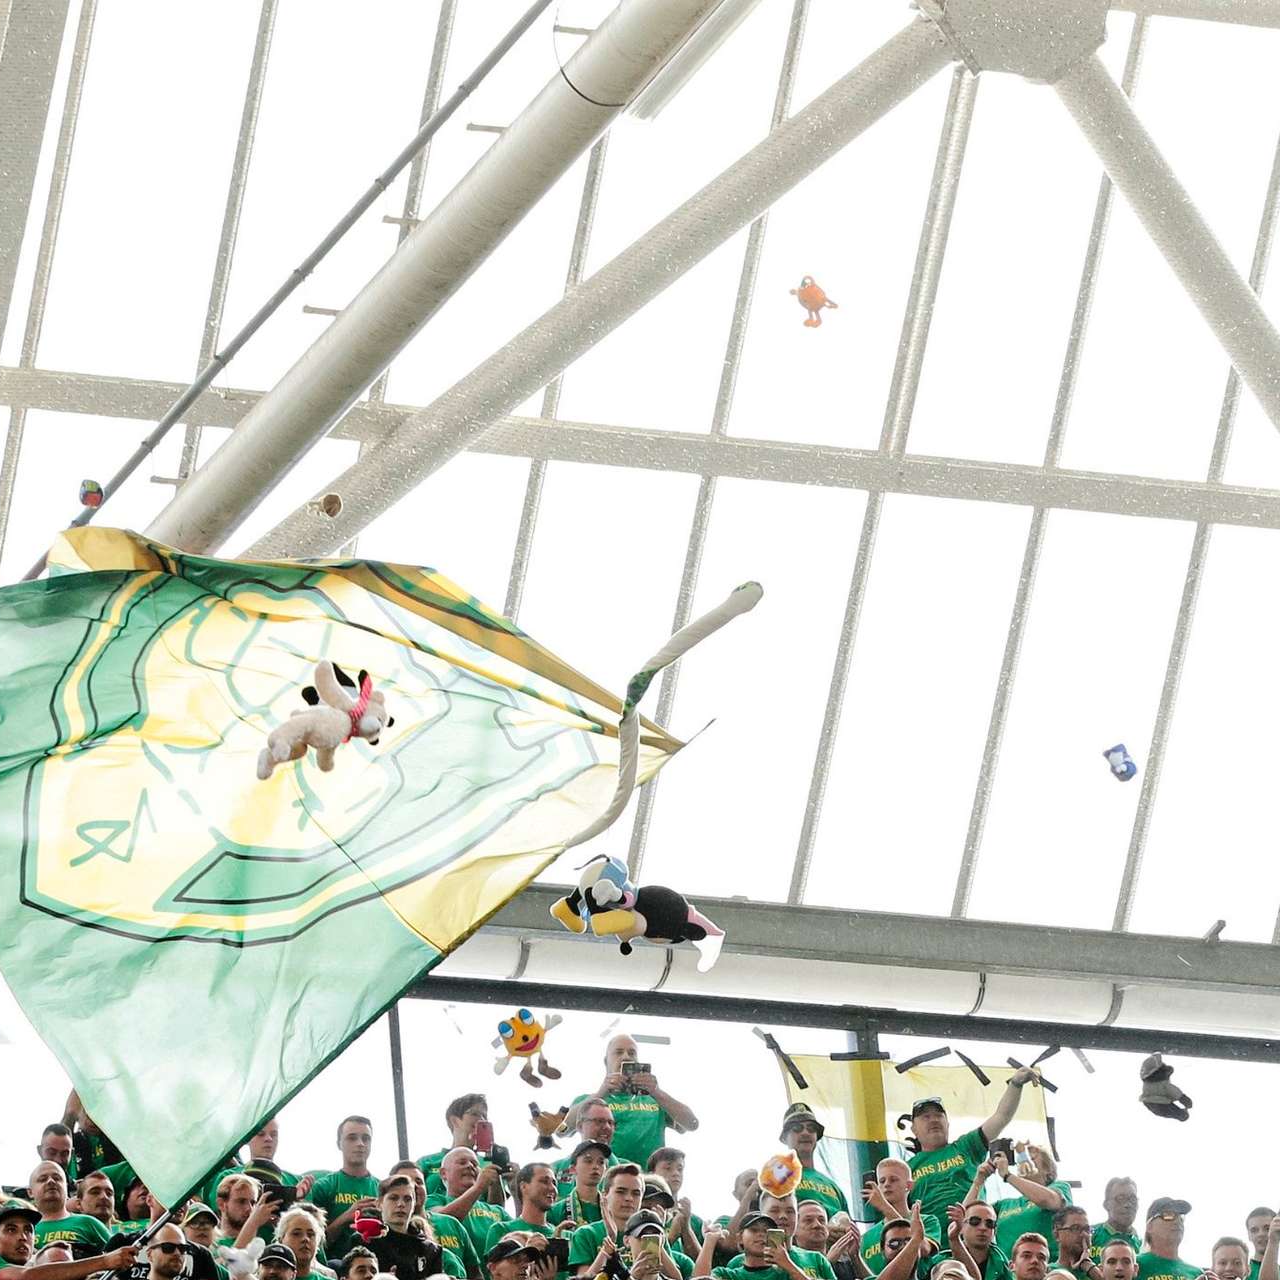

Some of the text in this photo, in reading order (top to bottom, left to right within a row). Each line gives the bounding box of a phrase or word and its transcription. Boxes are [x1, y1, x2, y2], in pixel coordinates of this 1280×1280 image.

[937, 1155, 965, 1171] JEANS
[43, 1231, 78, 1245] JEANS
[131, 1267, 150, 1280] DE
